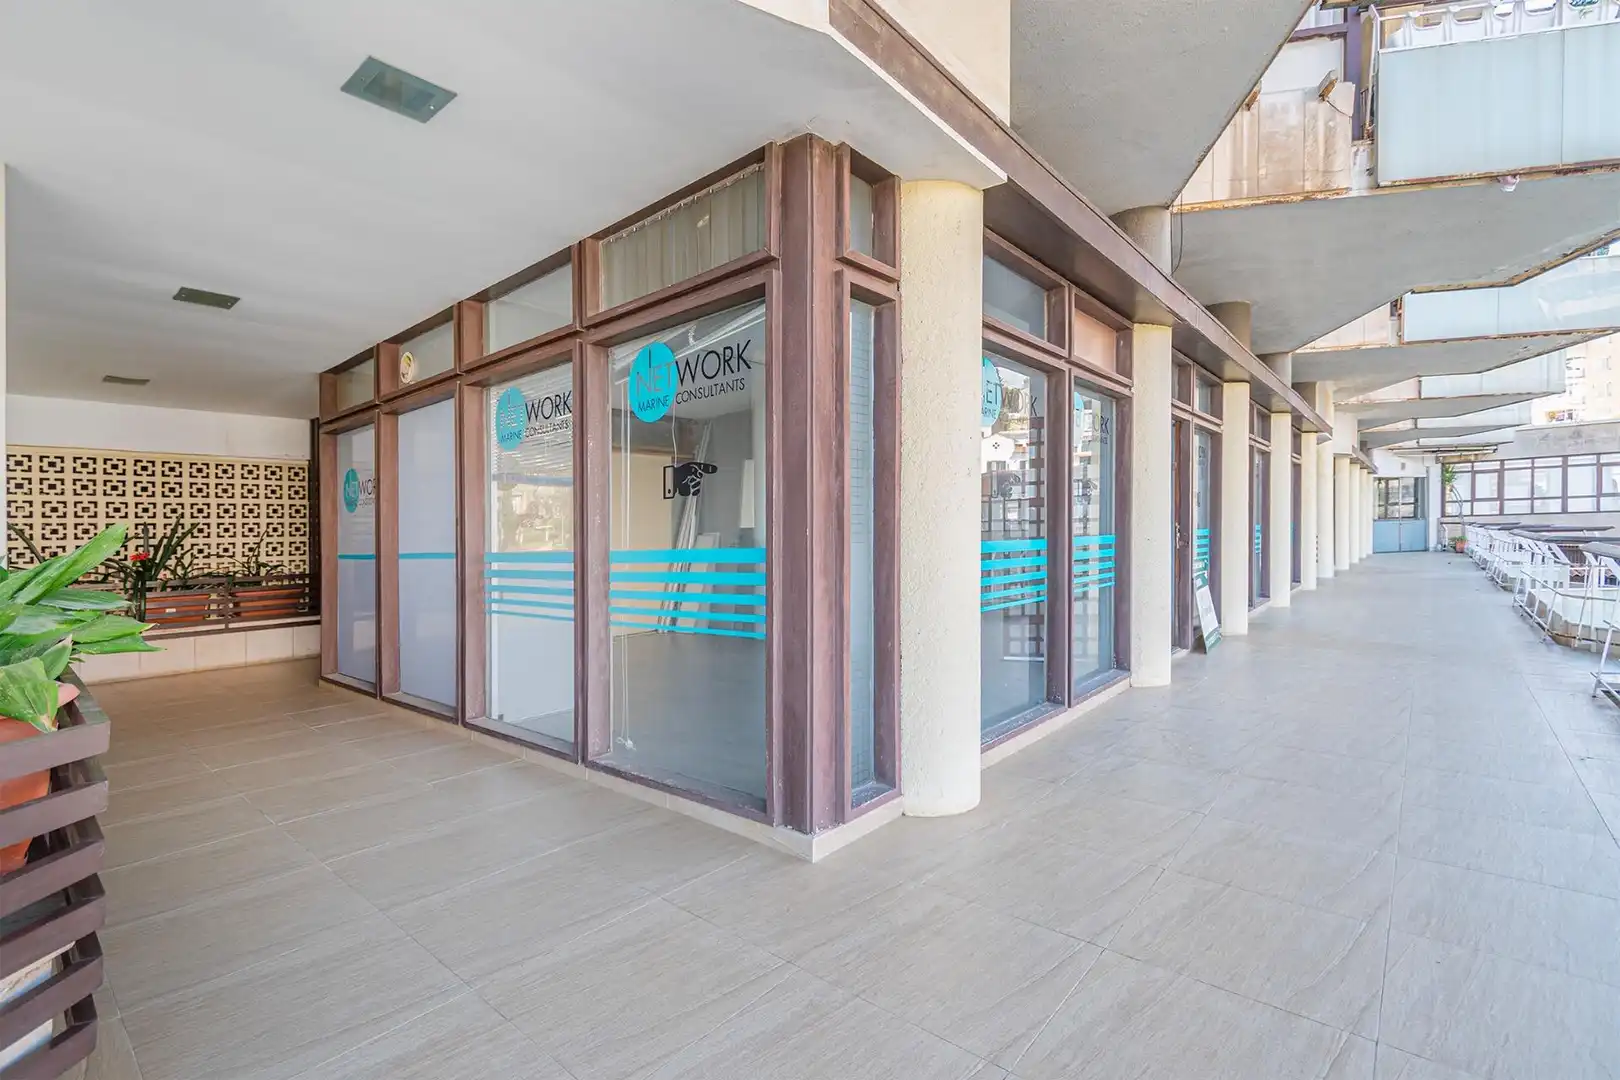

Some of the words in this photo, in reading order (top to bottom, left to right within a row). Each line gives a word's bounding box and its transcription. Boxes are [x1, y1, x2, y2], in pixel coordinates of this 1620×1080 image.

[636, 339, 752, 397] NETWORK
[638, 395, 670, 413] MARINE
[675, 378, 746, 405] CONSULTANTS
